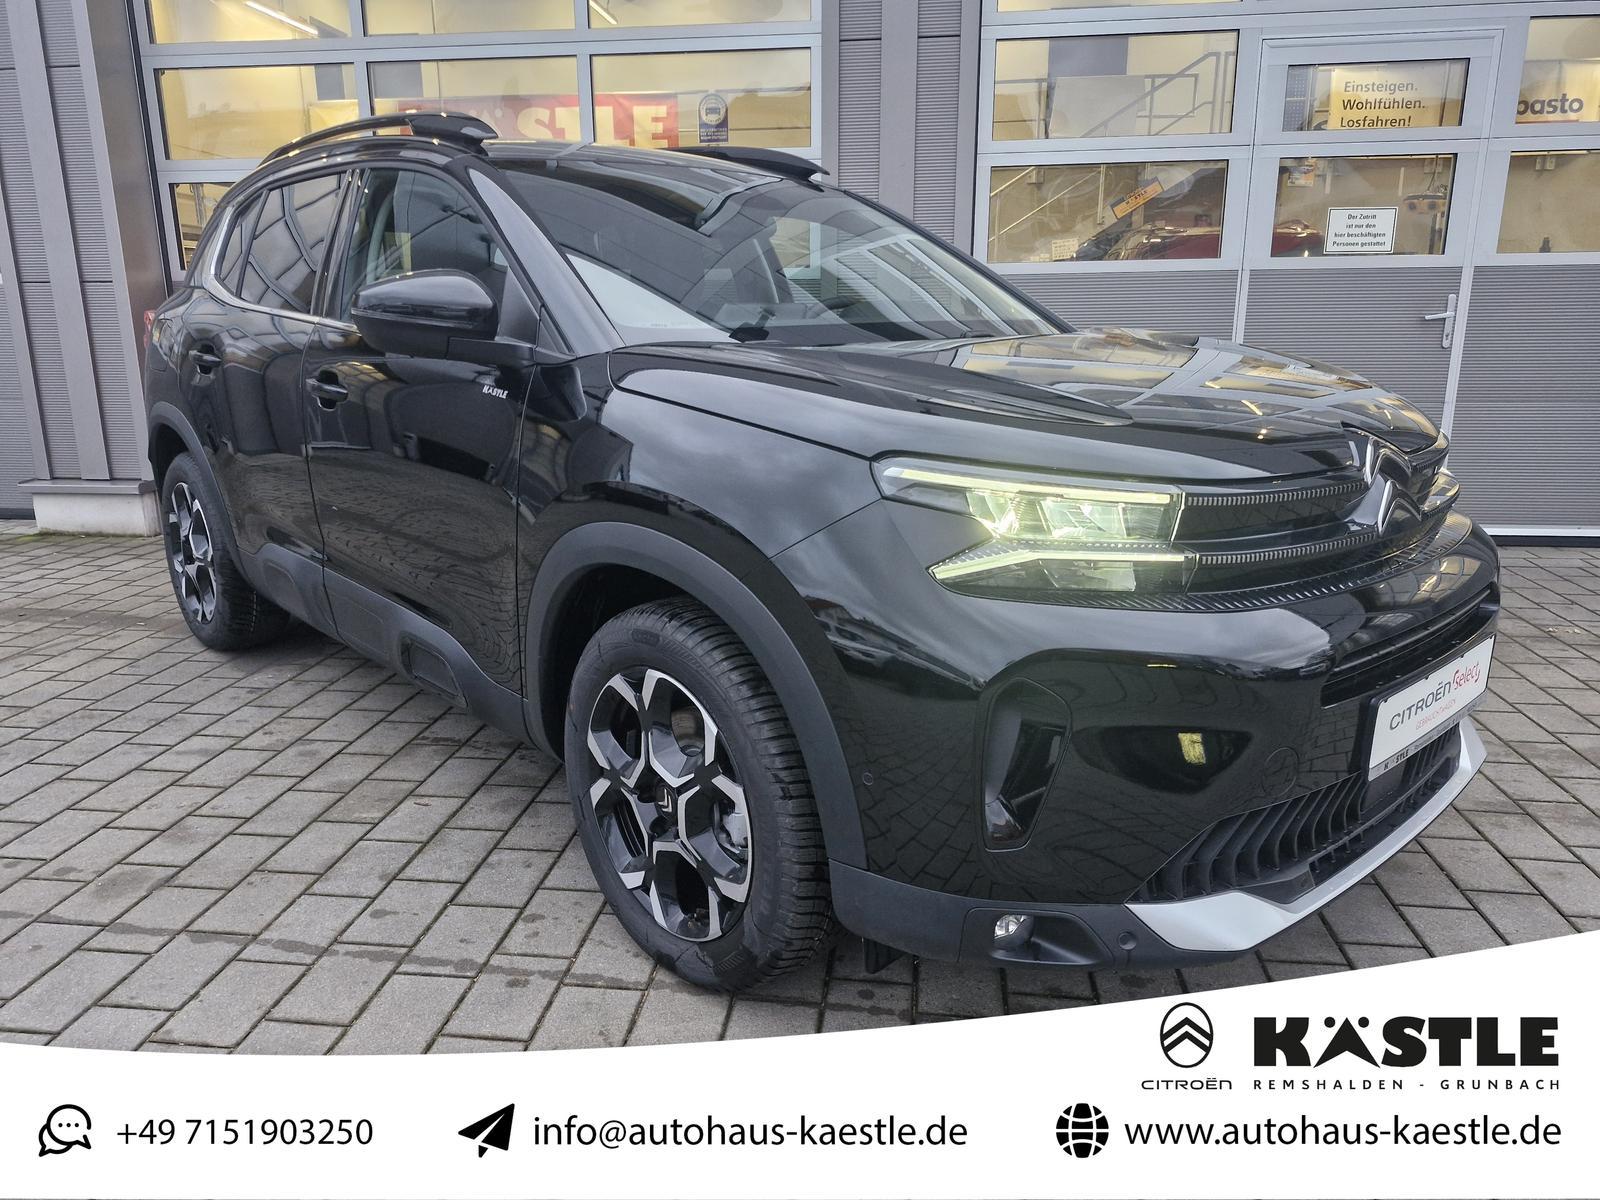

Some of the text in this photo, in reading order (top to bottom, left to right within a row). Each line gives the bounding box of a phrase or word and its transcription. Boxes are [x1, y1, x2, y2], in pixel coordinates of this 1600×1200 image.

[1344, 80, 1418, 95] Einsteigen.
[1342, 97, 1426, 111] Wohlfühlen.
[1340, 115, 1412, 128] Losfahren!
[1346, 231, 1386, 239] beschäftigten
